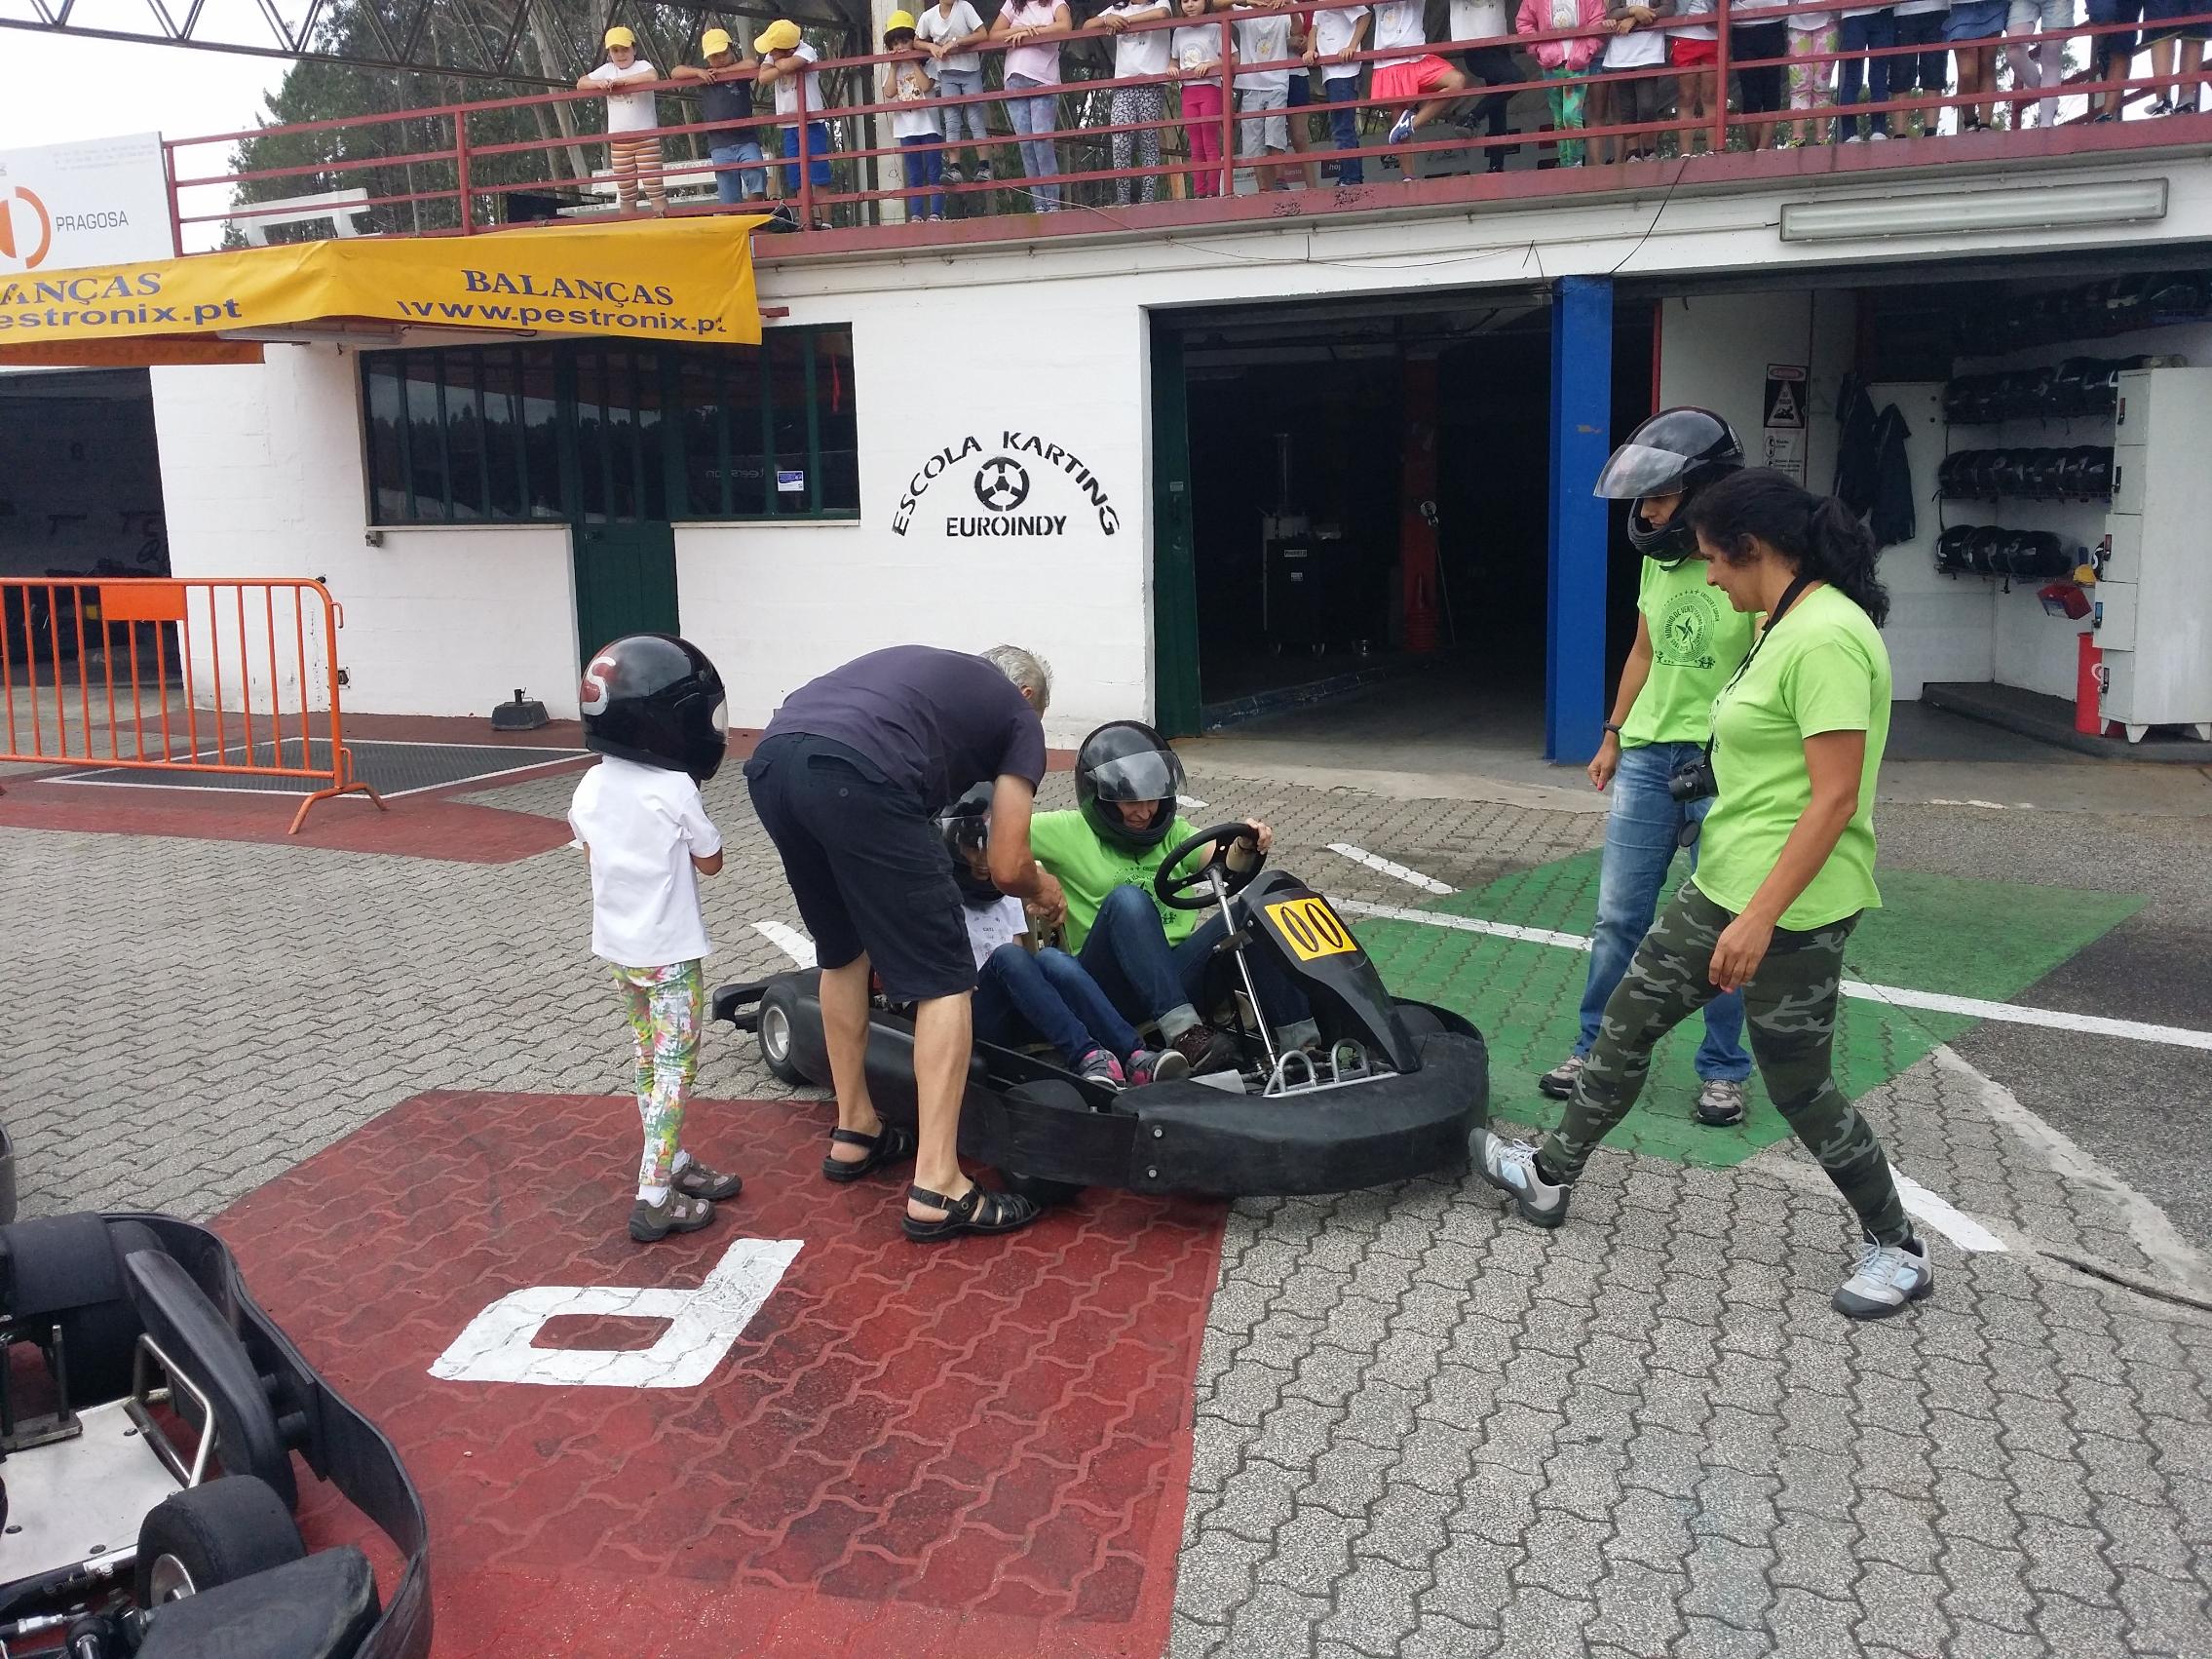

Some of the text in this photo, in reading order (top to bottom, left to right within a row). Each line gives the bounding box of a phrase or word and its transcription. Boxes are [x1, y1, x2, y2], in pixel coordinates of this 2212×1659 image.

[56, 211, 130, 232] PRAGOSA
[461, 269, 674, 308] BALANÇAS
[892, 431, 1120, 537] ESCOLA KARTING
[946, 516, 1067, 537] EUROINDY
[1280, 903, 1343, 952] 00
